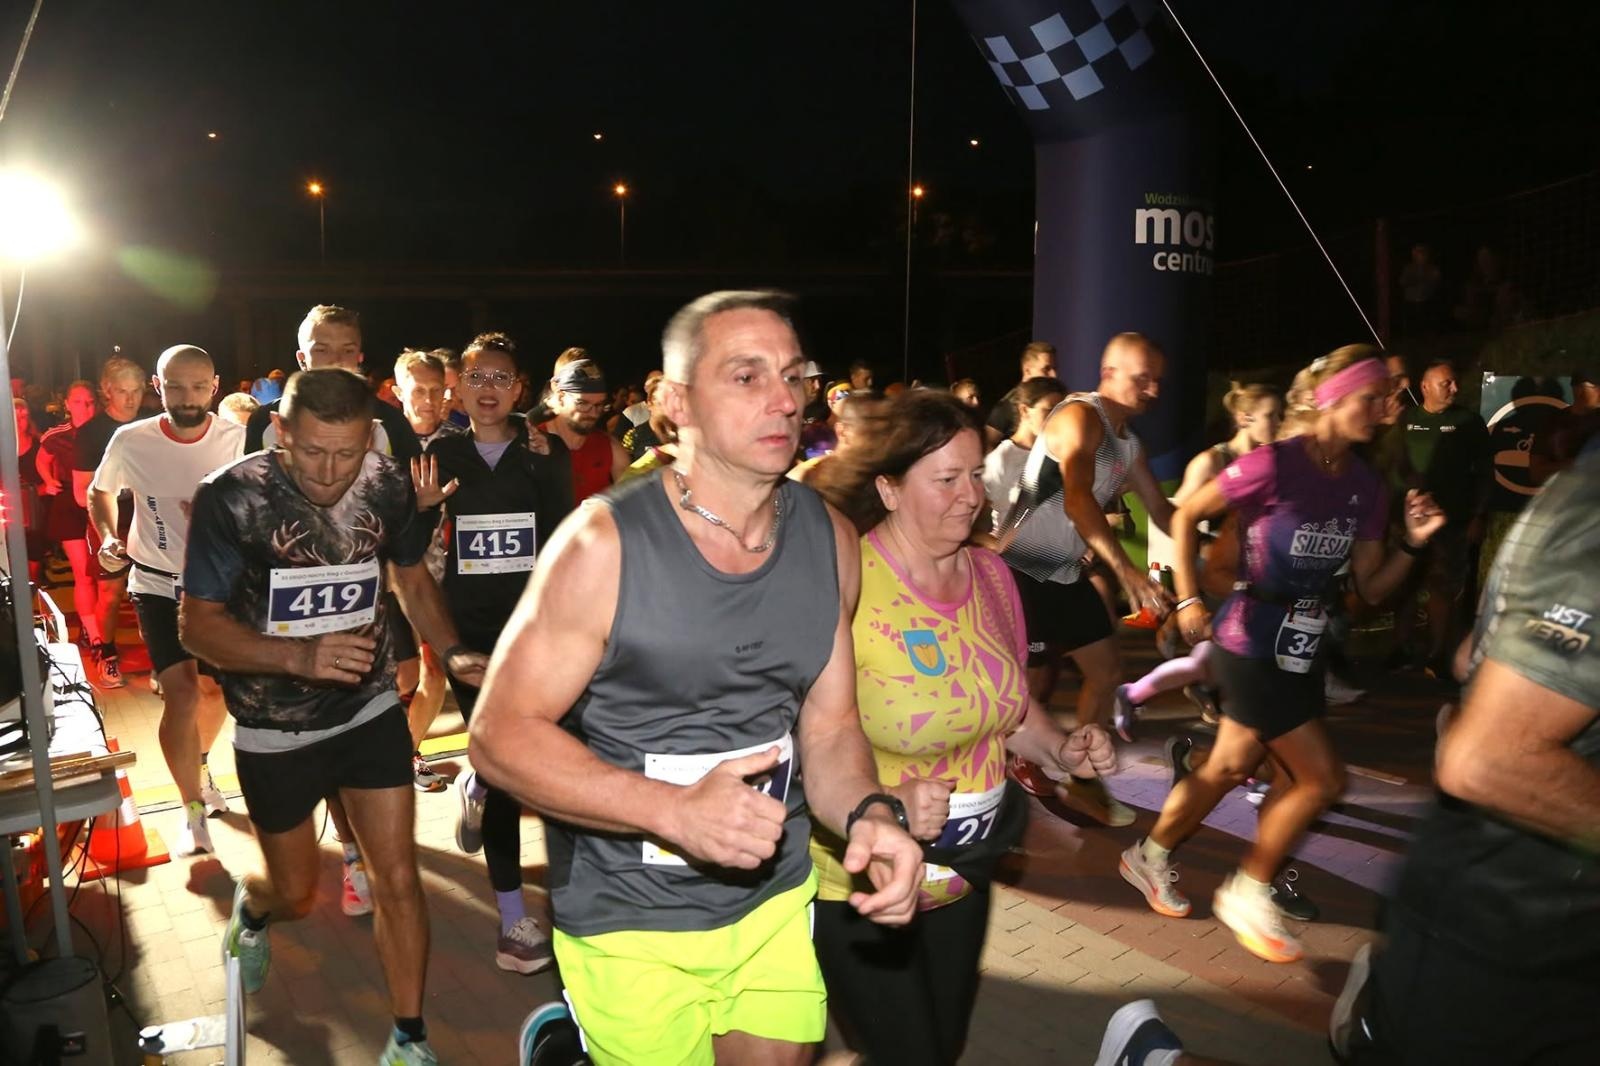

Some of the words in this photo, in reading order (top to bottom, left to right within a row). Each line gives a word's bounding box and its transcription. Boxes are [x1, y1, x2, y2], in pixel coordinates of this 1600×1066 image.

[469, 530, 521, 557] 415
[1294, 533, 1349, 557] SILESIA
[289, 583, 363, 616] 419
[1287, 633, 1321, 657] 34
[956, 807, 999, 846] 27
